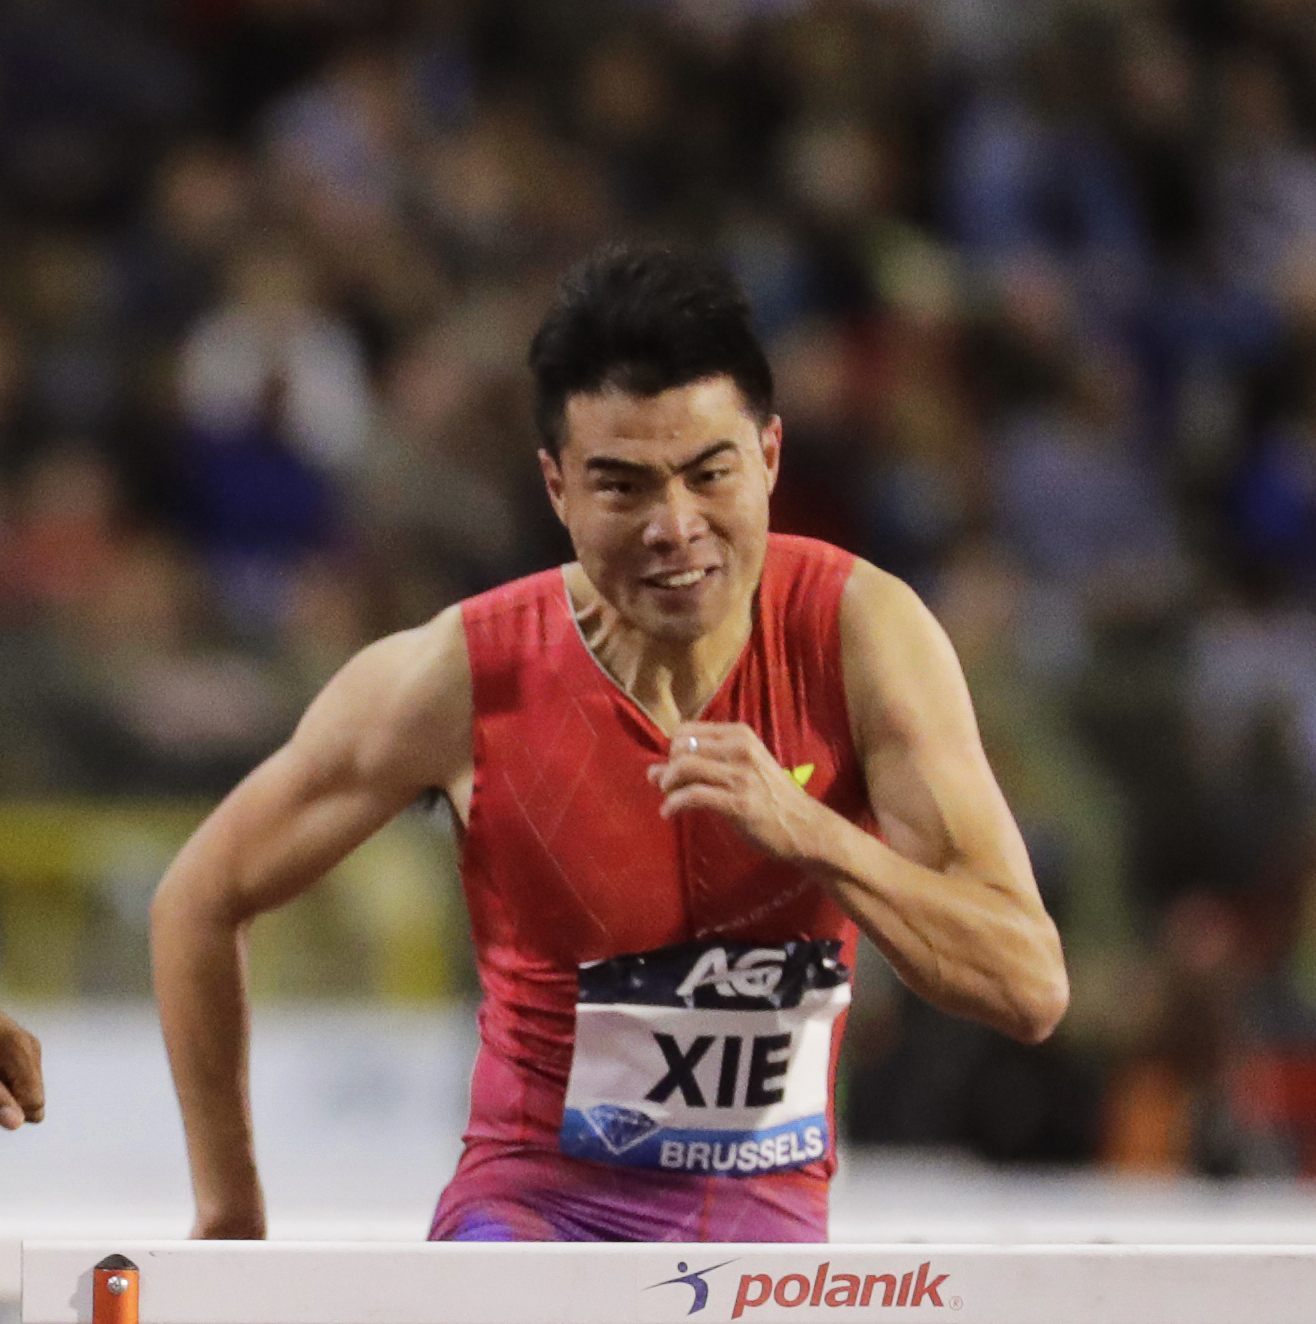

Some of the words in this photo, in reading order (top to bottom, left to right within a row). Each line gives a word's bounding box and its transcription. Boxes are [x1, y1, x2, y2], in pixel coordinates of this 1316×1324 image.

[644, 1032, 792, 1108] XIE
[659, 1127, 824, 1172] BRUSSELS
[730, 1260, 951, 1320] polanik
